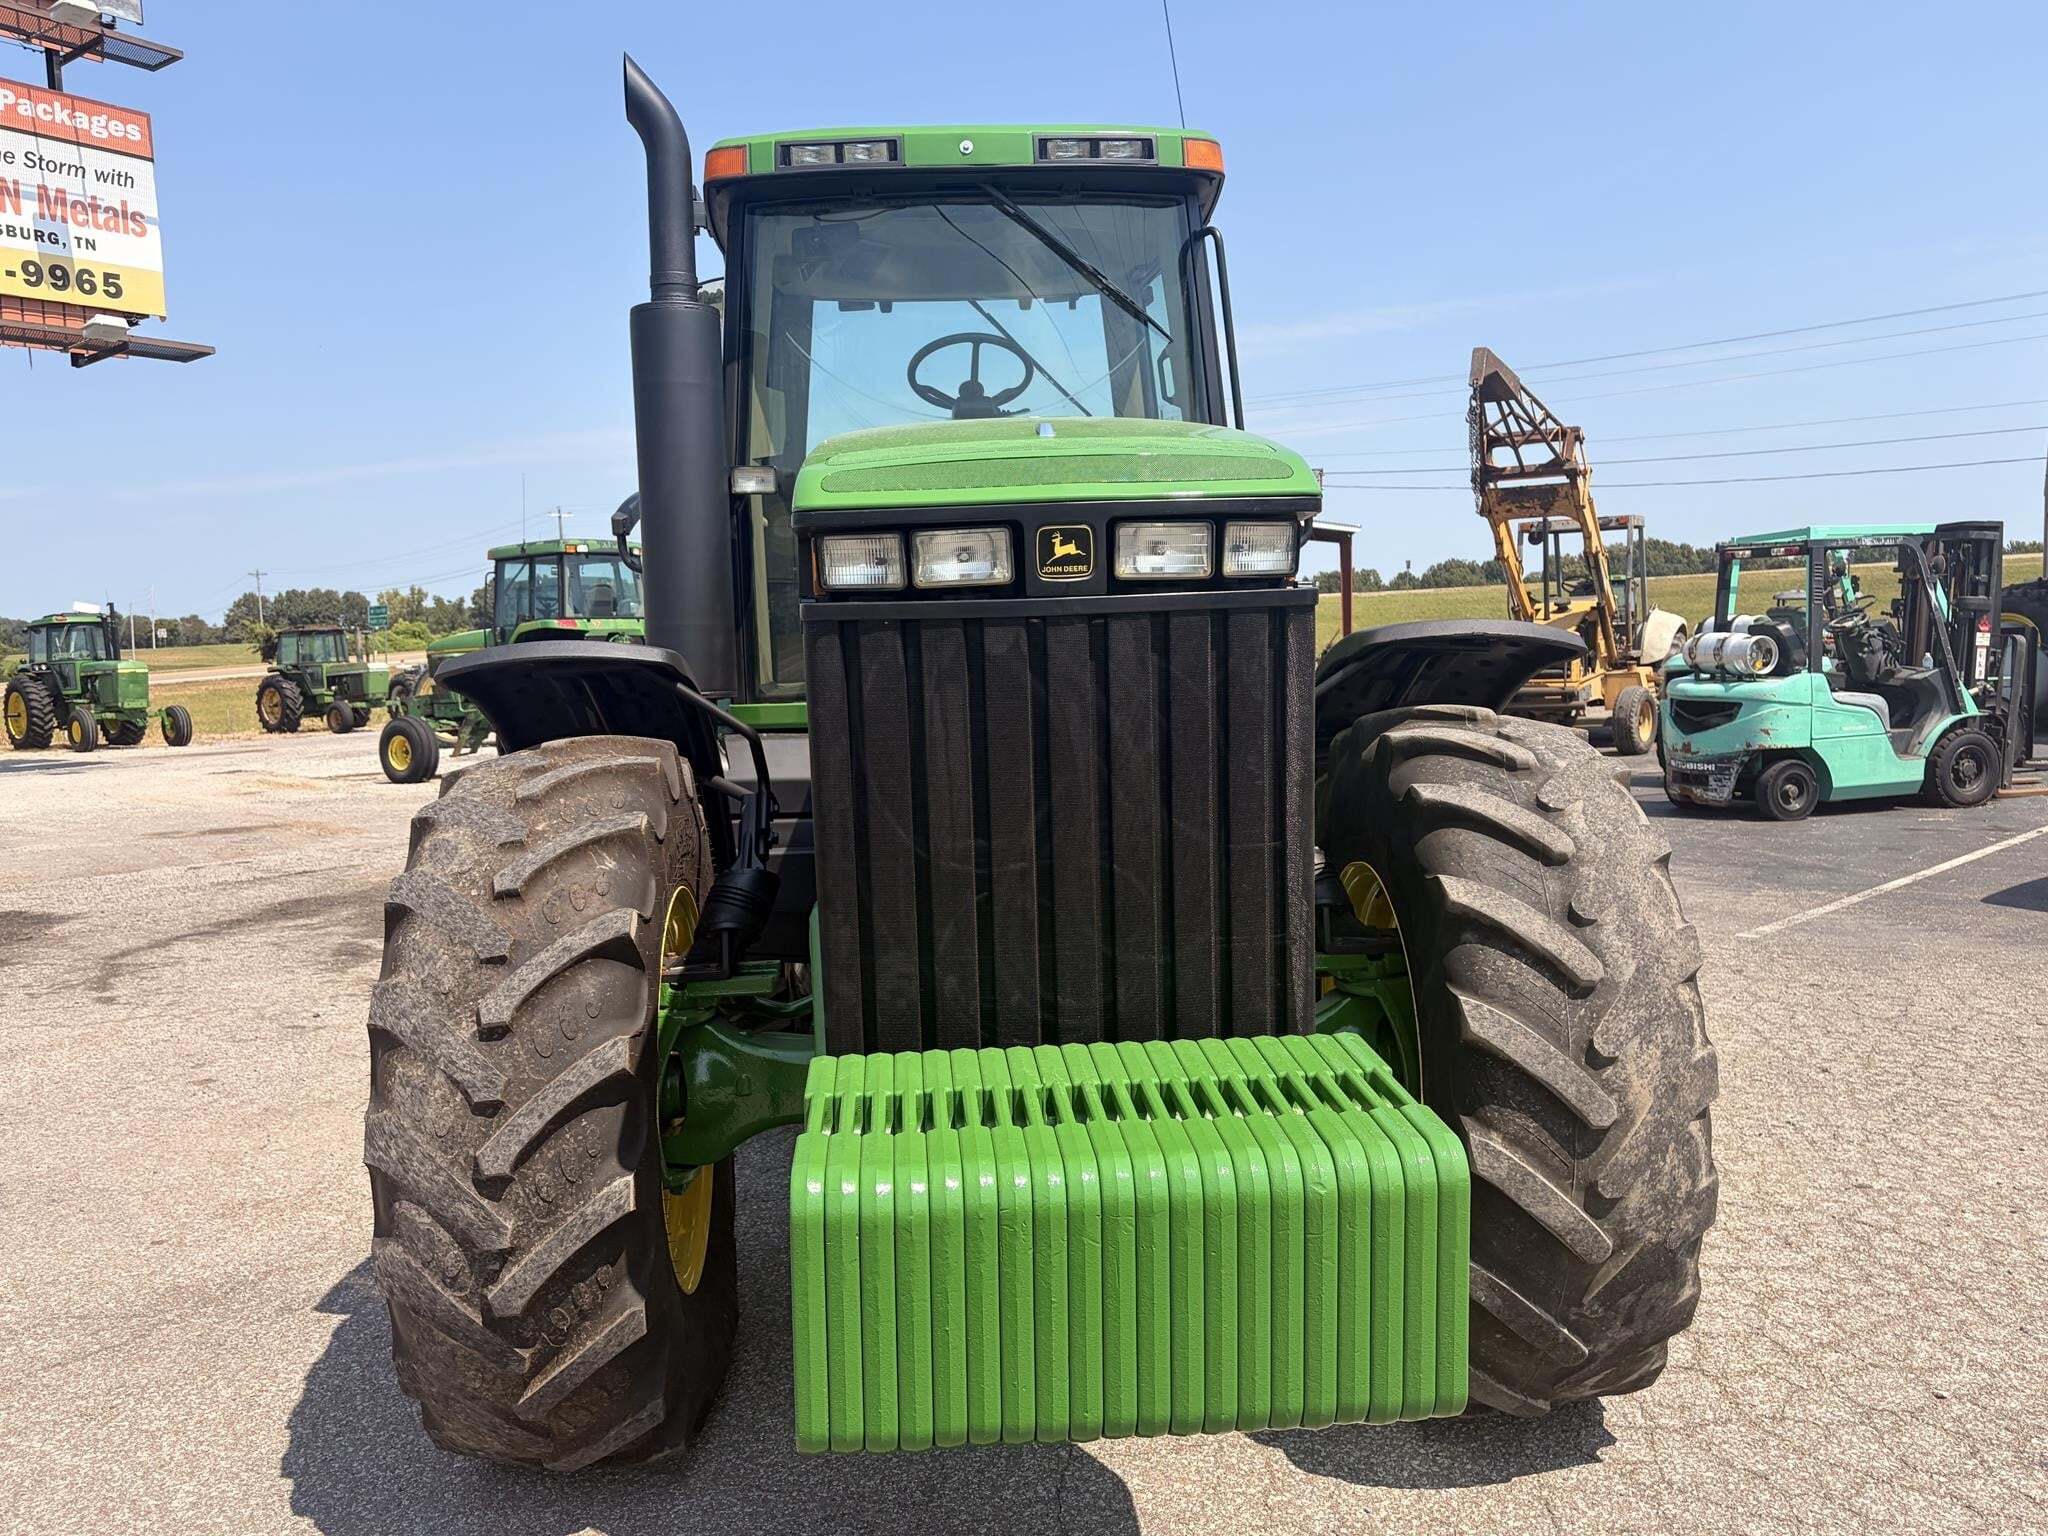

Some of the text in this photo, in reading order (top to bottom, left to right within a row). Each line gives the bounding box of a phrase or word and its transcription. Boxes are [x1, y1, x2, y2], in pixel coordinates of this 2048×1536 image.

[0, 88, 142, 141] Packages
[23, 150, 85, 179] Storm
[94, 169, 134, 188] with
[37, 184, 148, 237] Metals
[74, 236, 96, 251] TN
[5, 259, 123, 299] -9965
[1063, 565, 1088, 573] DEERE
